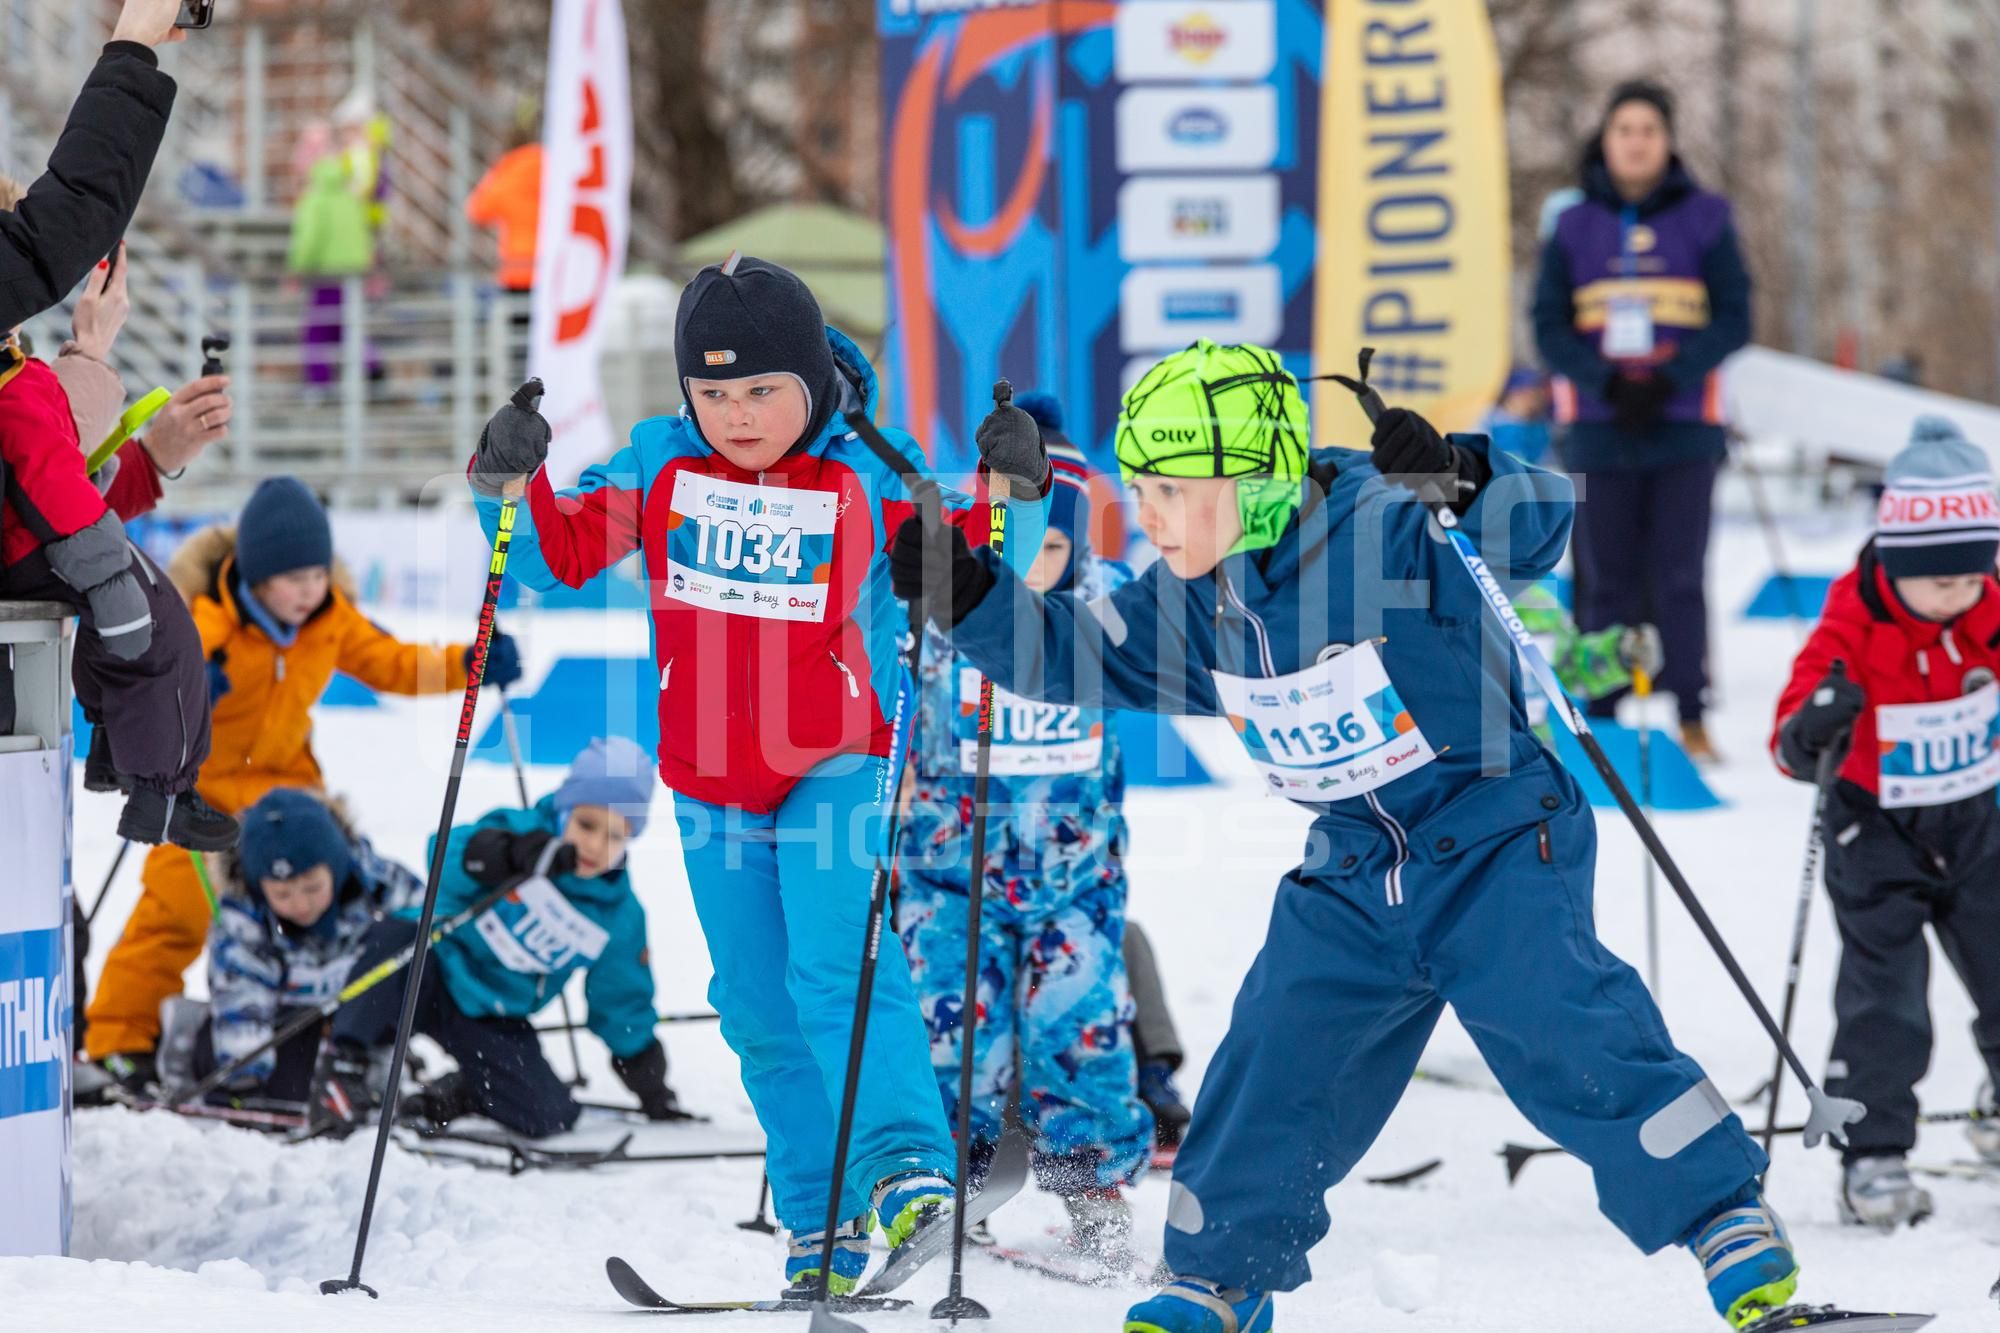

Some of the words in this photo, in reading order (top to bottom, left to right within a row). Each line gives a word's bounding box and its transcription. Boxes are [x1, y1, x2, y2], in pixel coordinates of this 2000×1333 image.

[1364, 0, 1455, 394] #PIONER
[1151, 429, 1196, 443] OLLY
[696, 514, 803, 578] 1034
[1465, 555, 1534, 647] NORDWAY
[992, 702, 1081, 742] 1022
[1269, 711, 1366, 758] 1136
[1910, 725, 1989, 775] 1012
